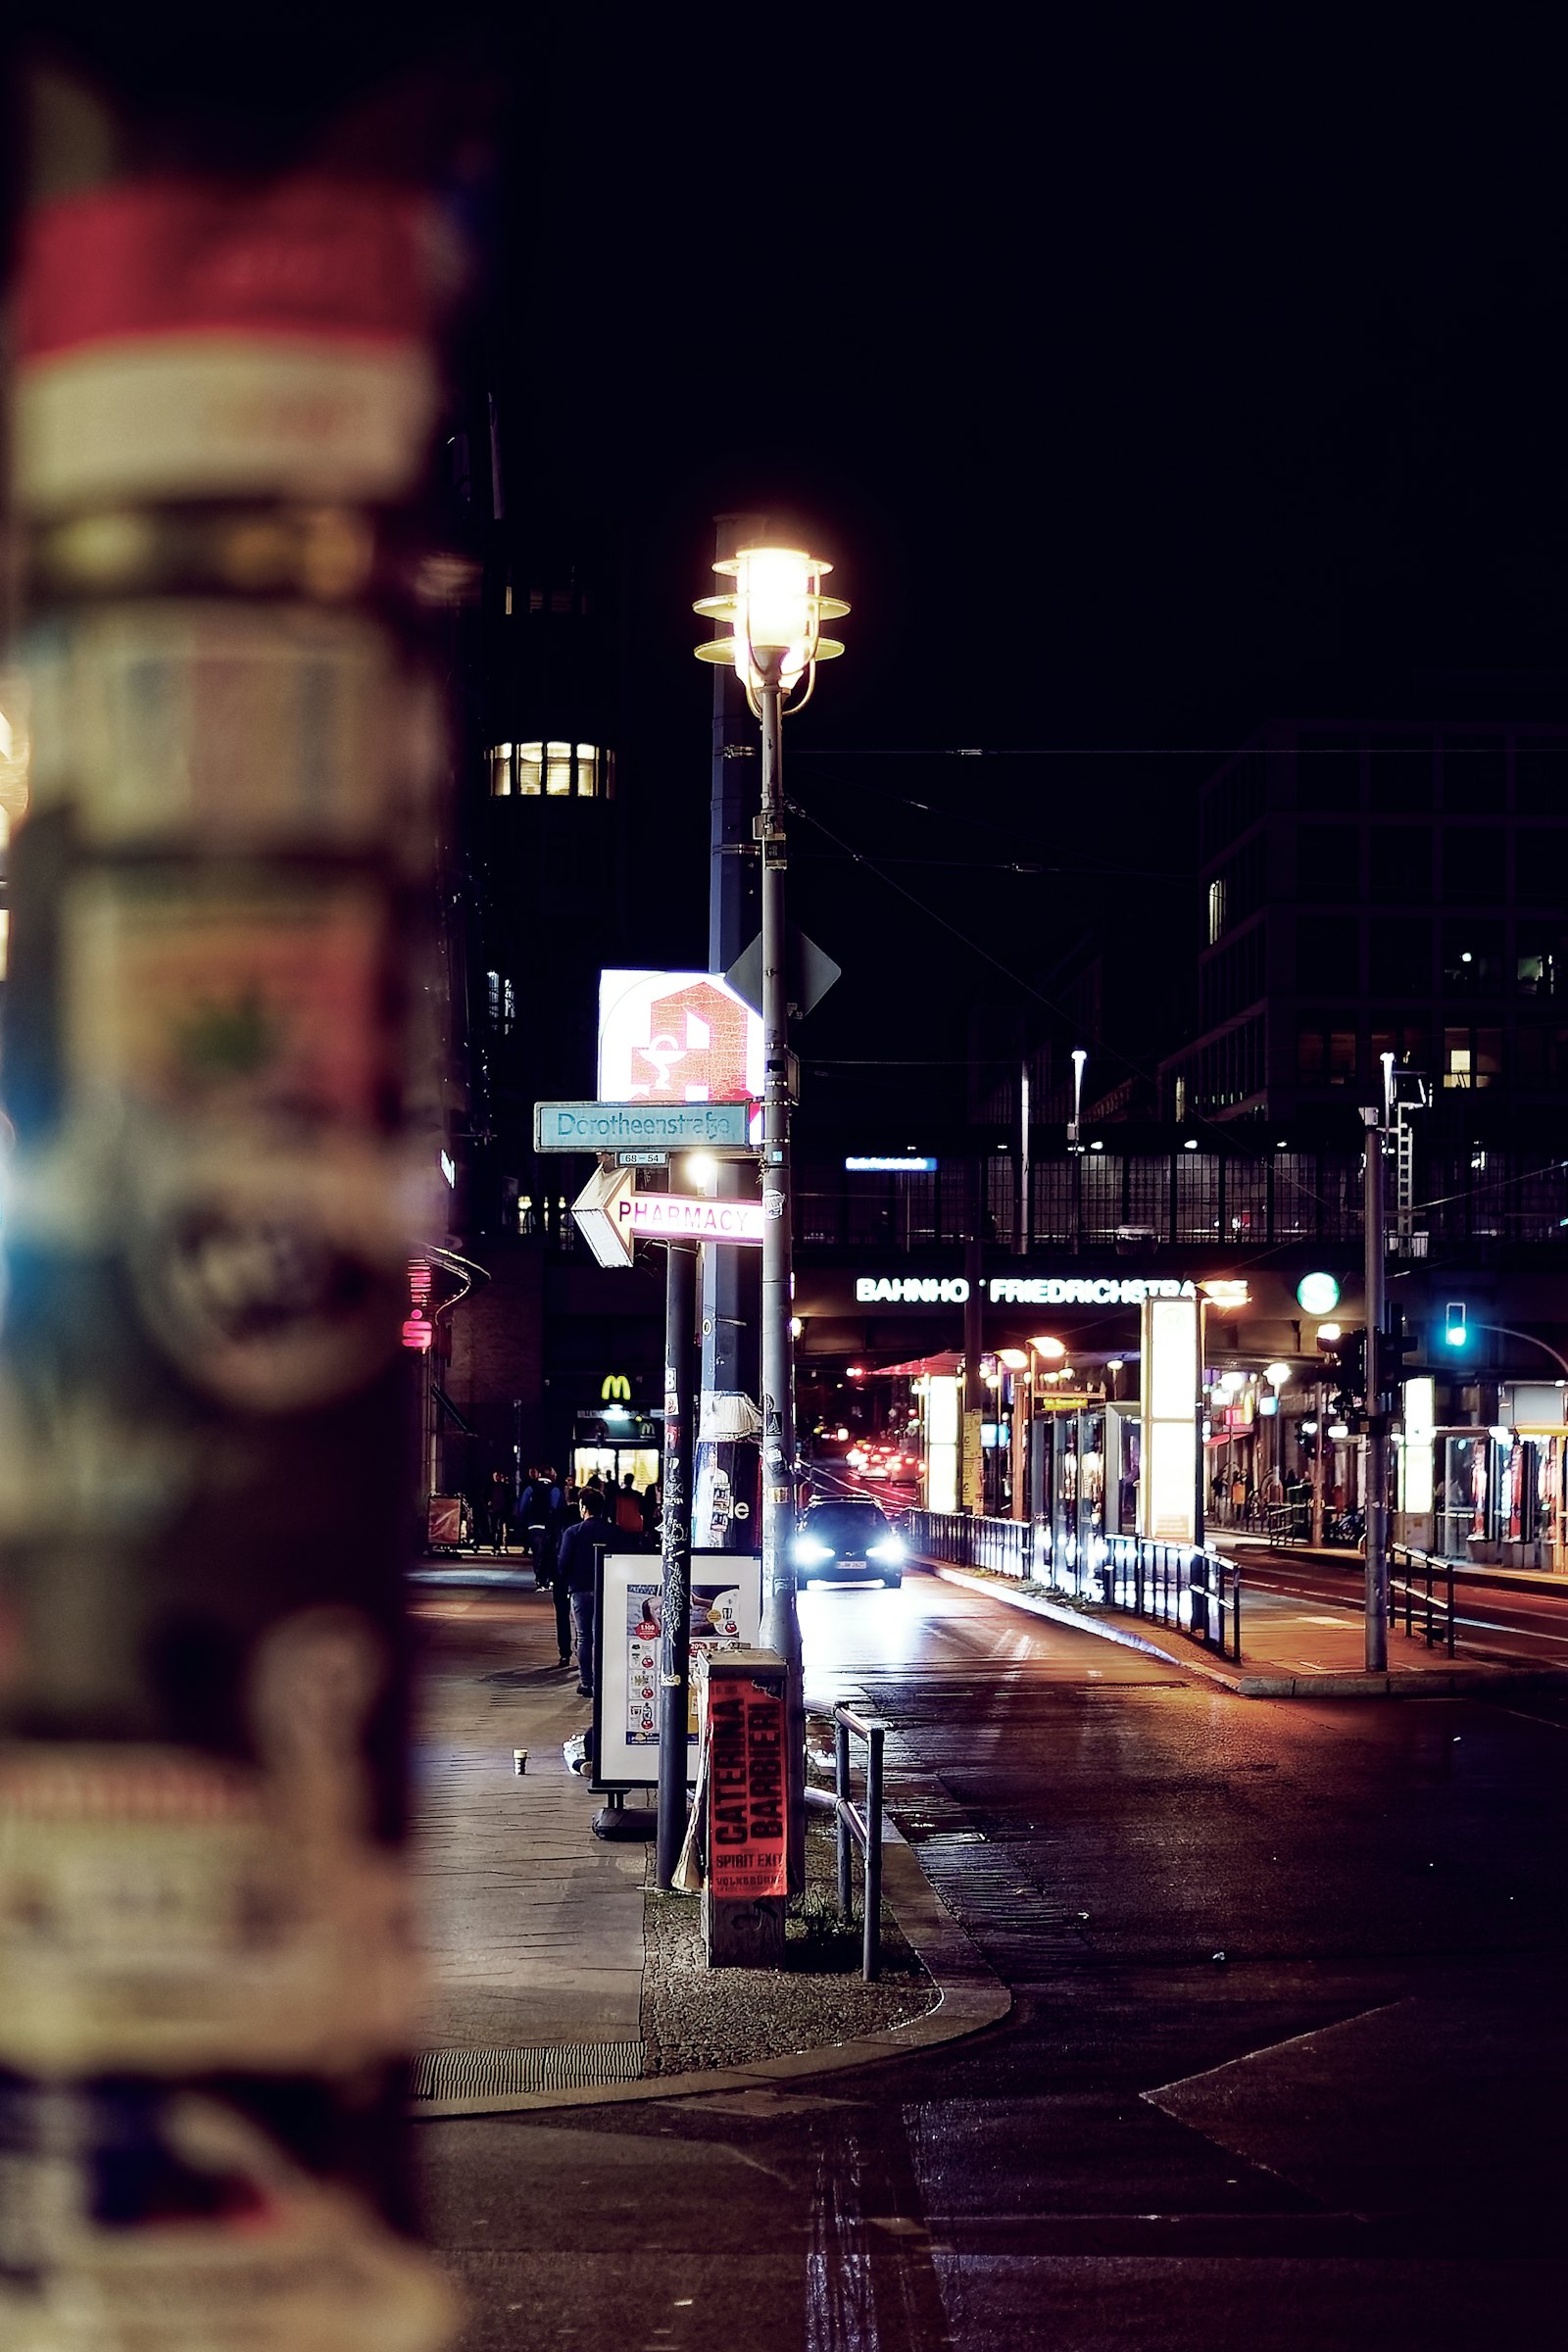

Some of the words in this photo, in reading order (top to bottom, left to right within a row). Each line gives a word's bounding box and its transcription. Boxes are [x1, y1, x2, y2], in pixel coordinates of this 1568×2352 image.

[619, 1200, 749, 1232] PHARMACY
[857, 1277, 986, 1303] BAHNHO
[713, 1698, 748, 1845] CATERINA
[748, 1702, 783, 1838] BARBIERI
[716, 1854, 754, 1868] SPIRIT
[758, 1852, 783, 1868] EXIT
